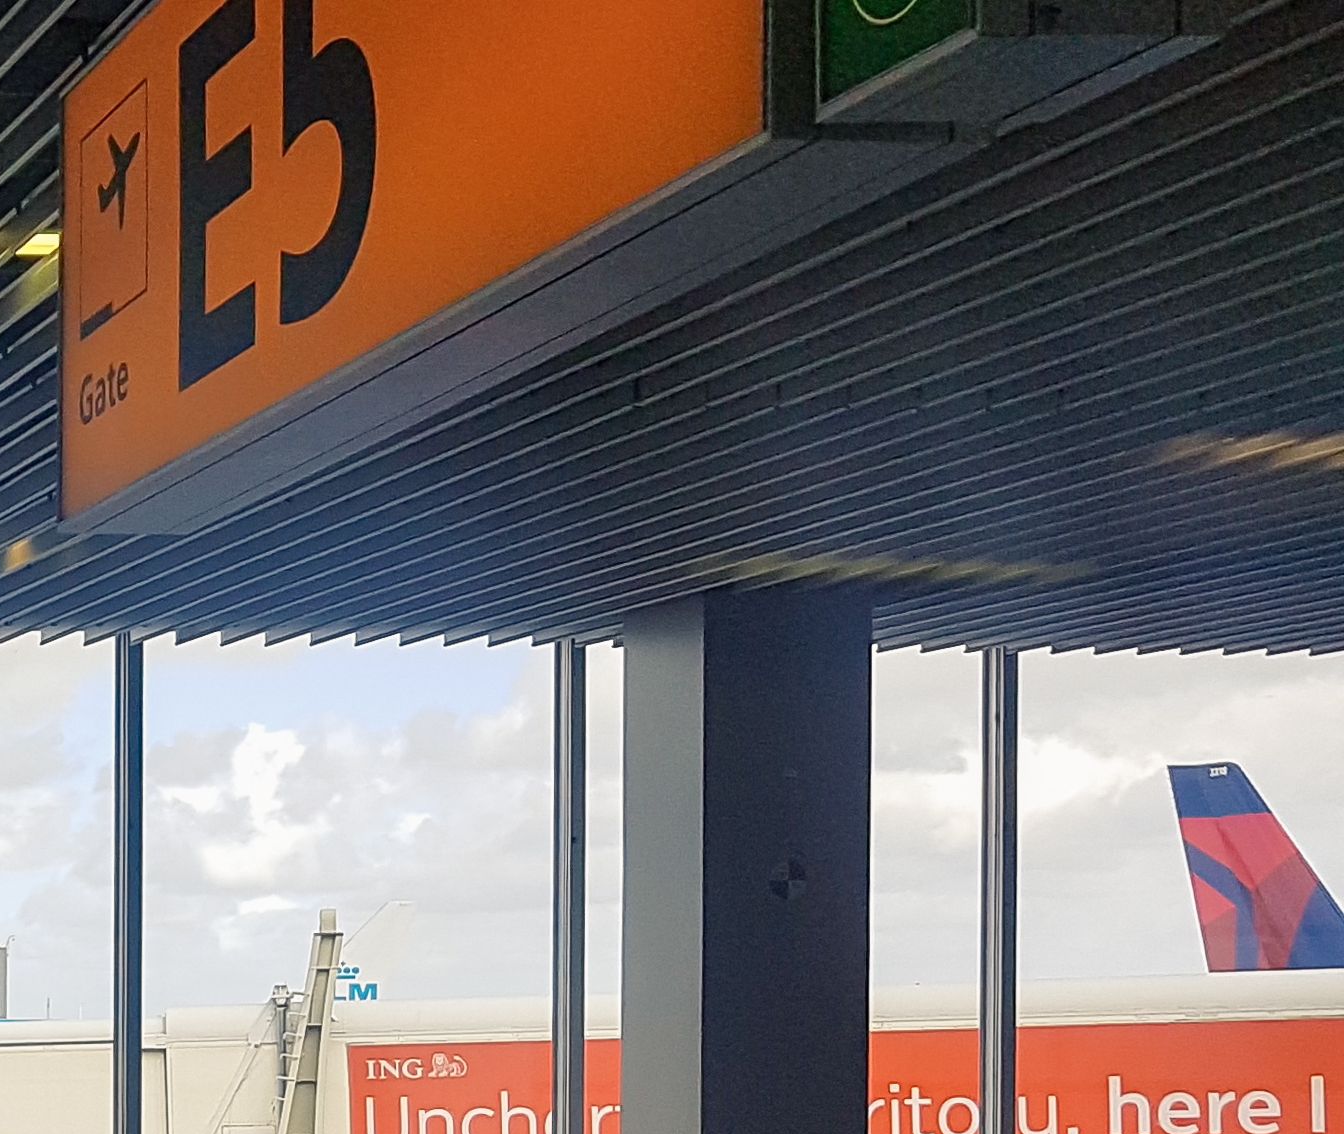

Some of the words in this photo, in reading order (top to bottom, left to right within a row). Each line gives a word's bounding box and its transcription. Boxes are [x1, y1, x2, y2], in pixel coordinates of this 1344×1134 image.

[179, 0, 377, 392] E5
[80, 361, 129, 425] Gate
[366, 1059, 424, 1080] ING
[1310, 1074, 1326, 1133] I
